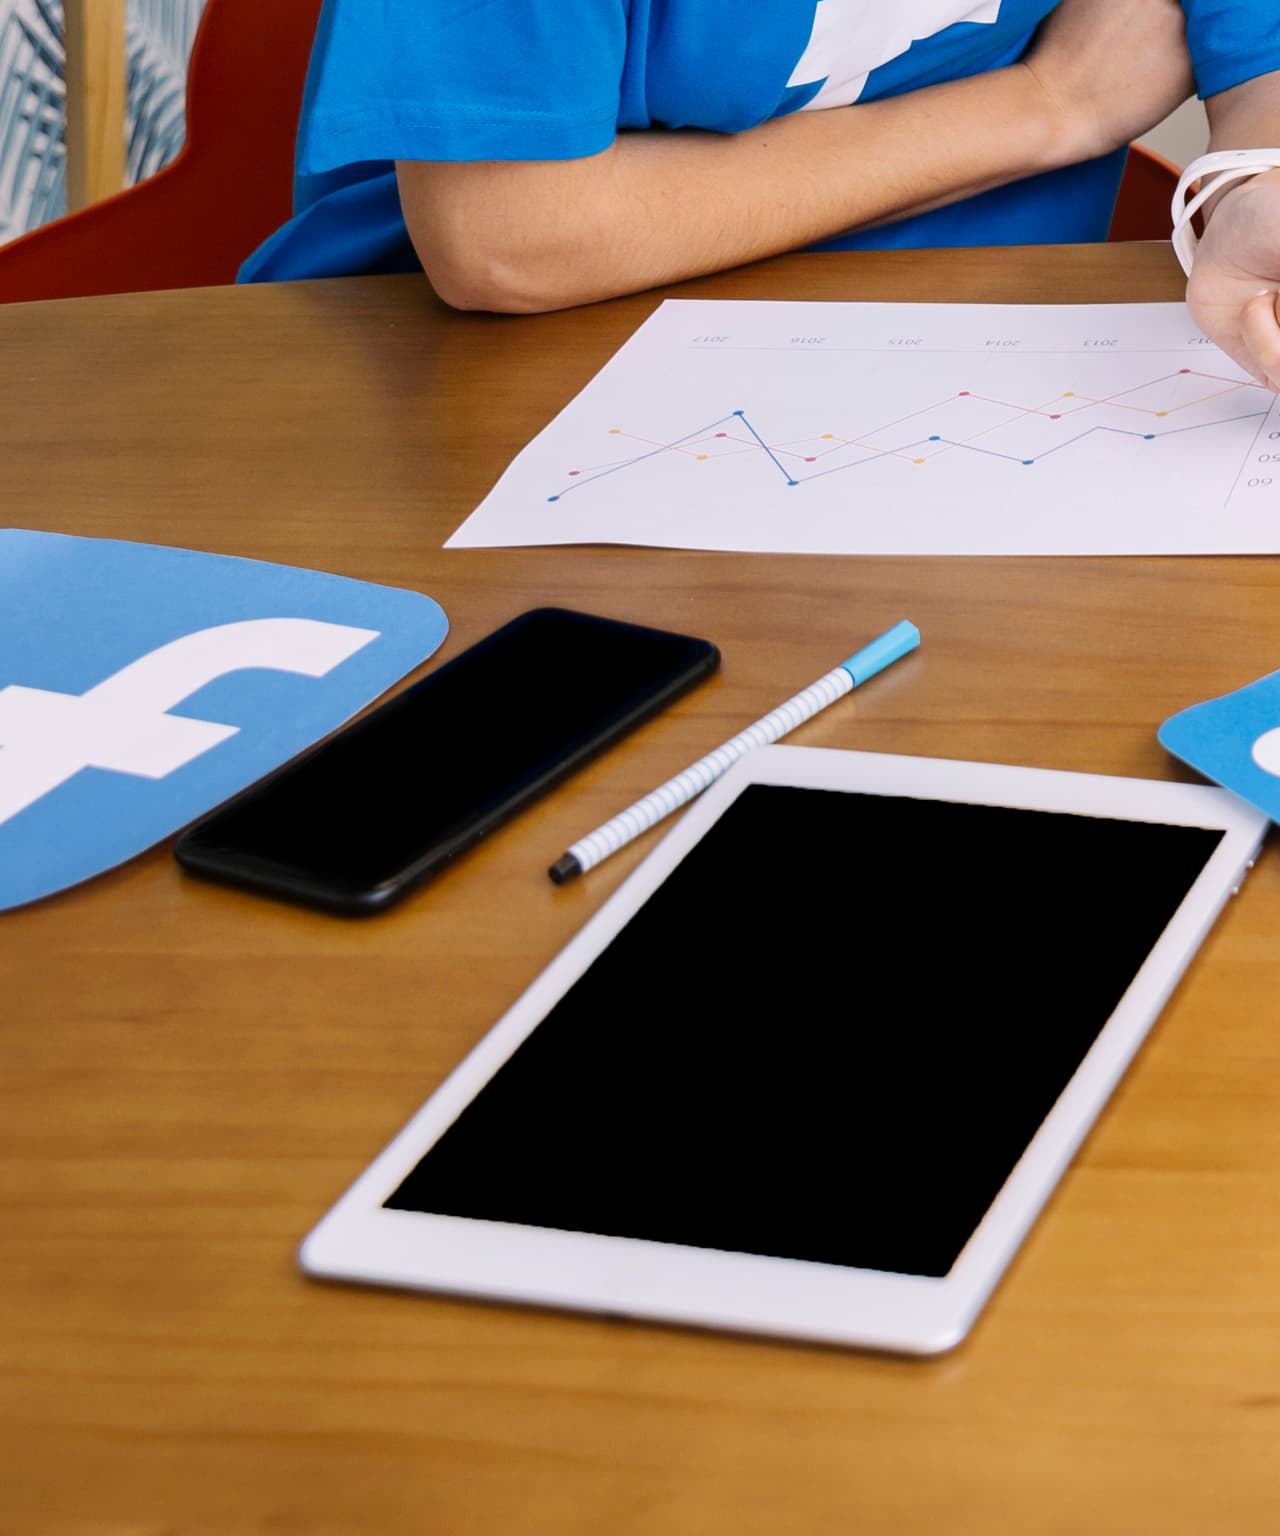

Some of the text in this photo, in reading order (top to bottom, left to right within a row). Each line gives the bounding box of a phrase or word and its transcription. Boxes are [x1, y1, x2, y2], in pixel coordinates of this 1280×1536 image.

[692, 335, 730, 344] 2017
[790, 336, 827, 345] 2016
[888, 337, 925, 346] 2015
[984, 339, 1021, 347] 2014
[1083, 339, 1119, 347] 2013
[1247, 477, 1273, 488] 60
